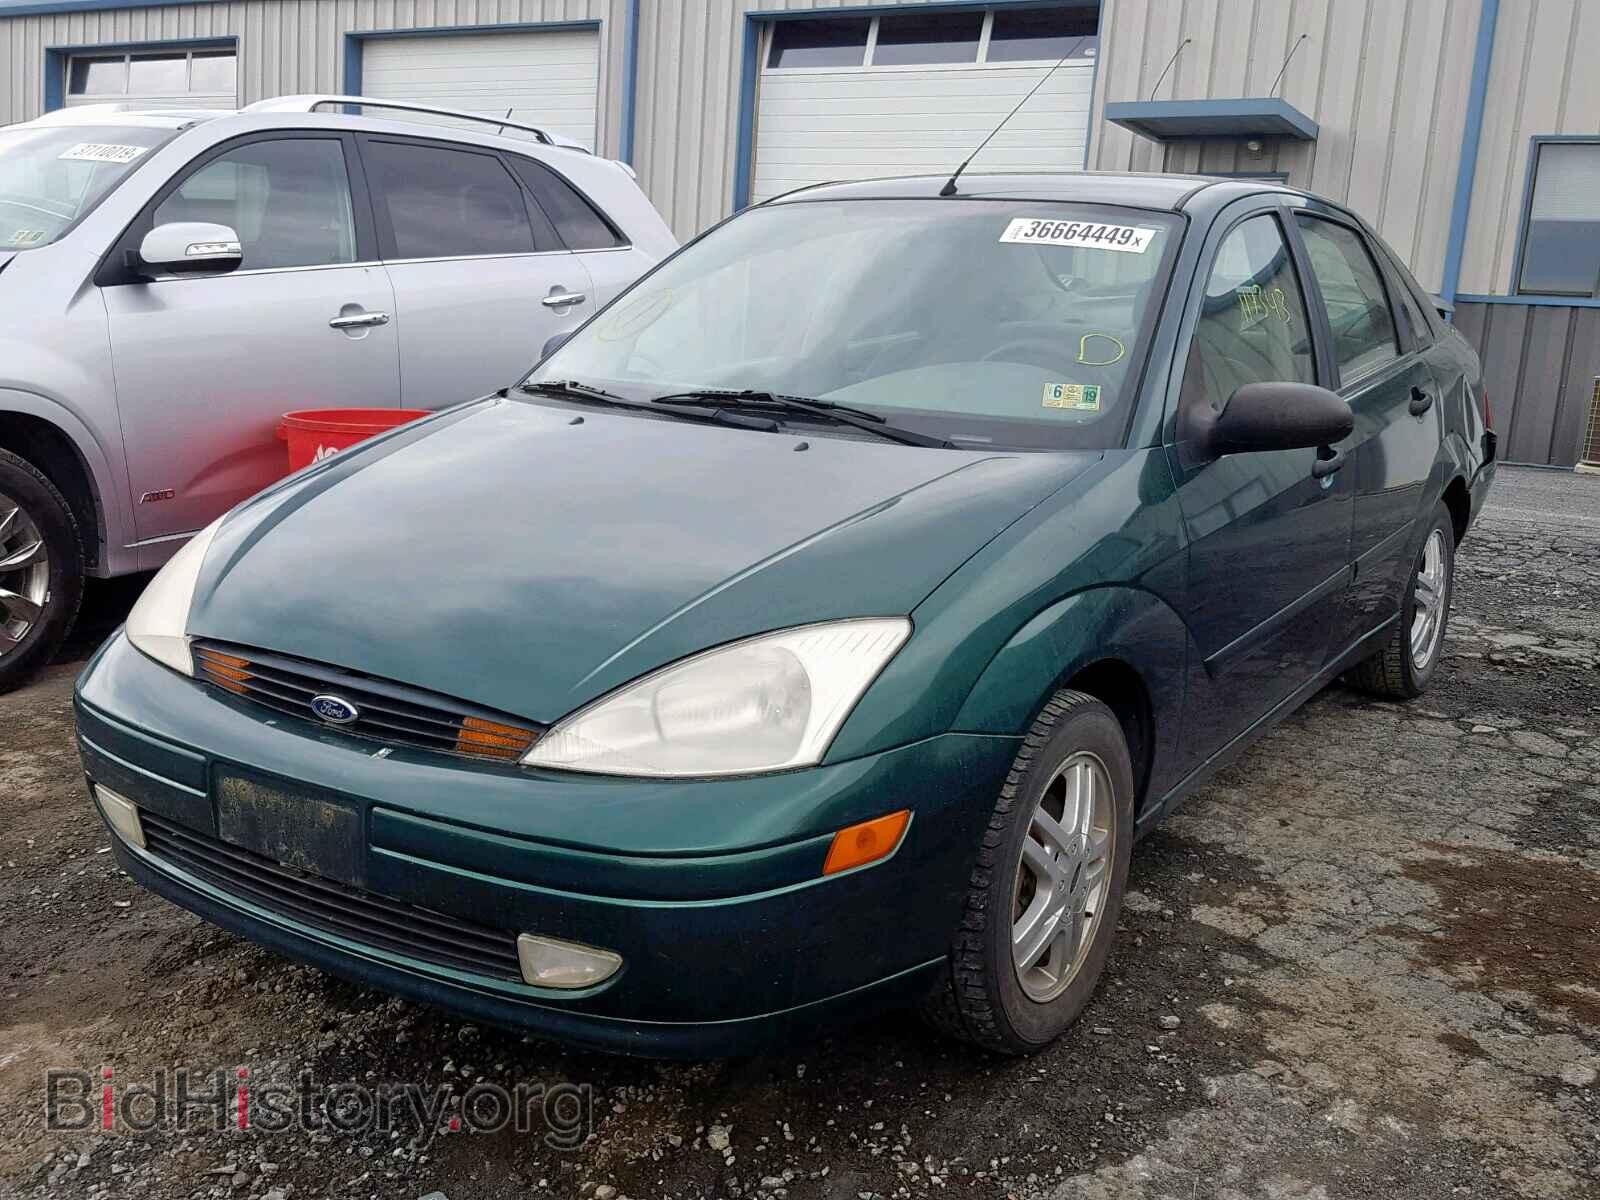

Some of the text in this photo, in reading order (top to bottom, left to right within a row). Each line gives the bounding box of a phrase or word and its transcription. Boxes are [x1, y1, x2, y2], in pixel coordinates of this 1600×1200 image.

[1053, 385, 1063, 398] 6
[1083, 390, 1097, 402] 19
[139, 489, 175, 504] AWD
[320, 700, 346, 719] Ford
